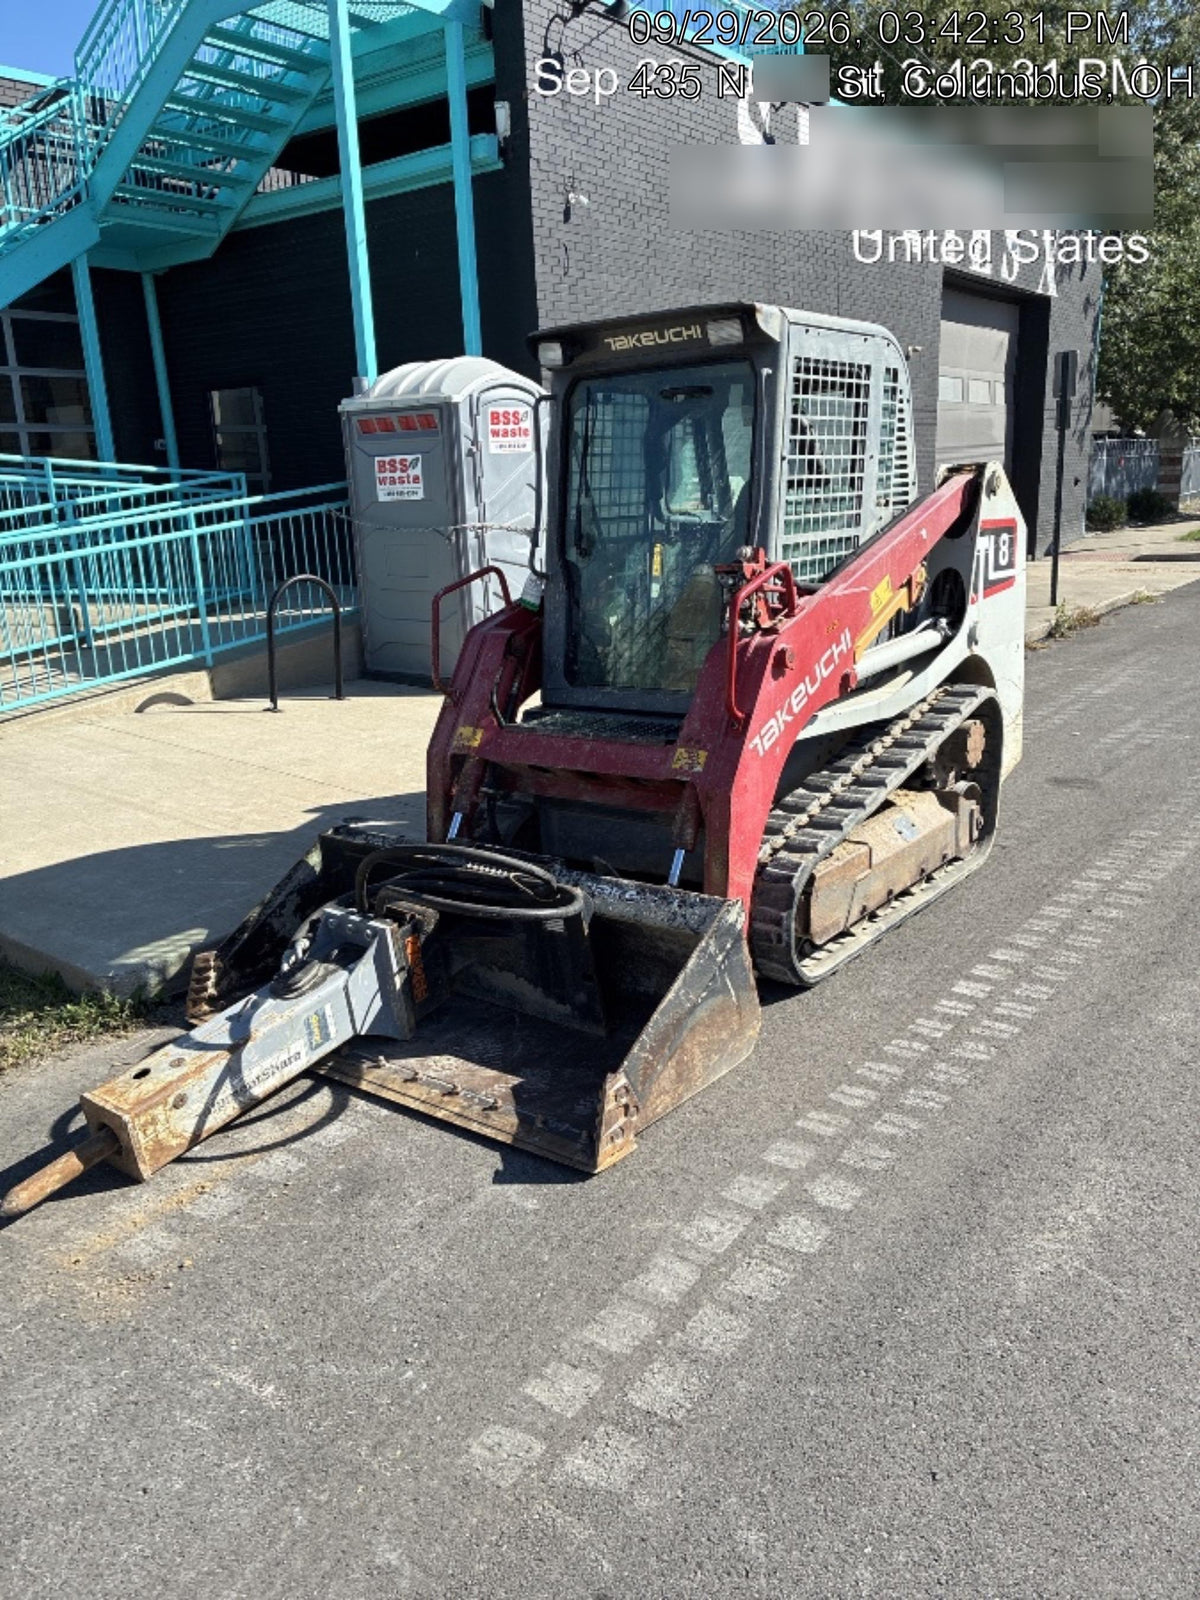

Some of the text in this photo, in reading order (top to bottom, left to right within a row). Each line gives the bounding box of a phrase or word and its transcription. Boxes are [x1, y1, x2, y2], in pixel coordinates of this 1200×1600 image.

[490, 410, 520, 425] BSS
[490, 426, 530, 438] waste
[376, 458, 409, 474] BSS
[378, 473, 420, 486] waste
